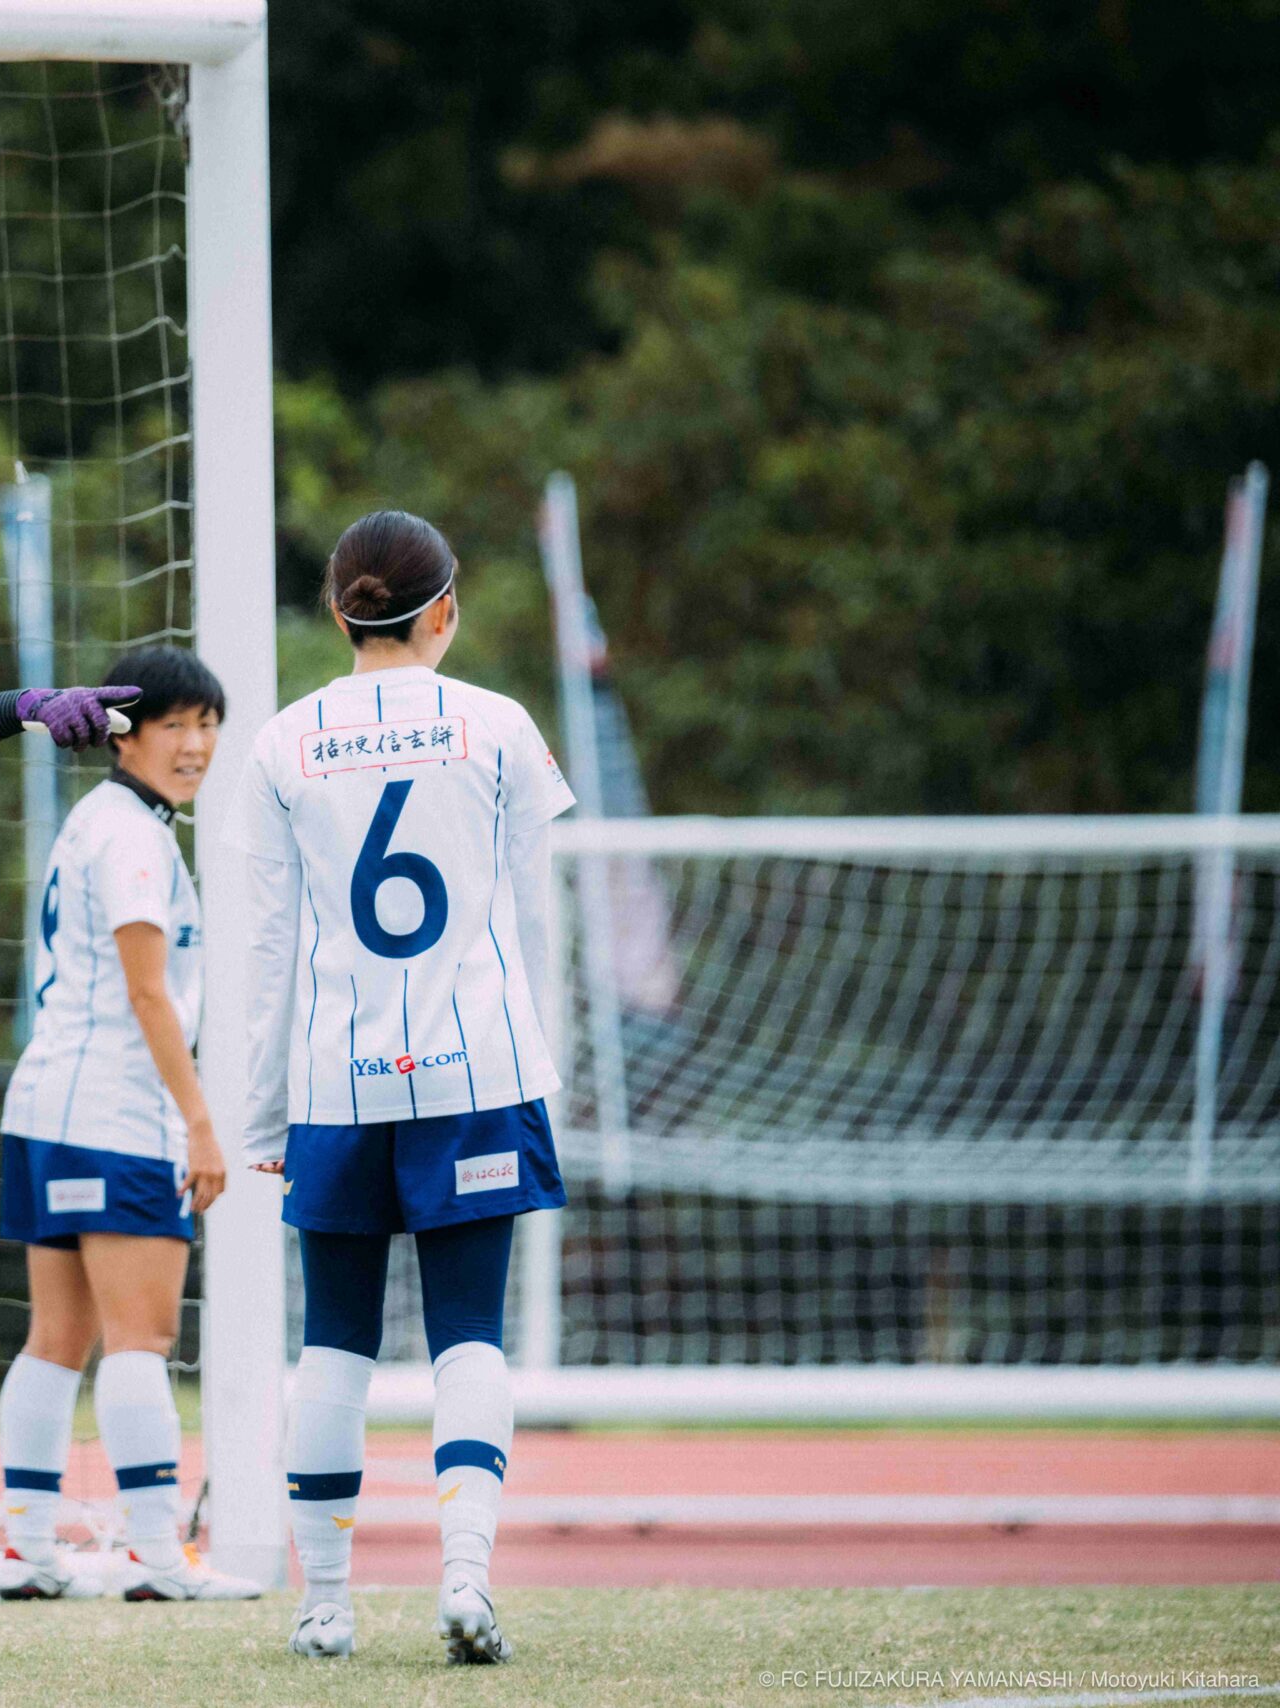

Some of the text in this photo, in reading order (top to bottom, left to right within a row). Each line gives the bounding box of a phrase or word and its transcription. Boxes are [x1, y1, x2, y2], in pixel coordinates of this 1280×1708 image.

[312, 725, 454, 763] 桔梗信玄餅
[350, 779, 449, 959] 6
[352, 1058, 394, 1077] Ysk
